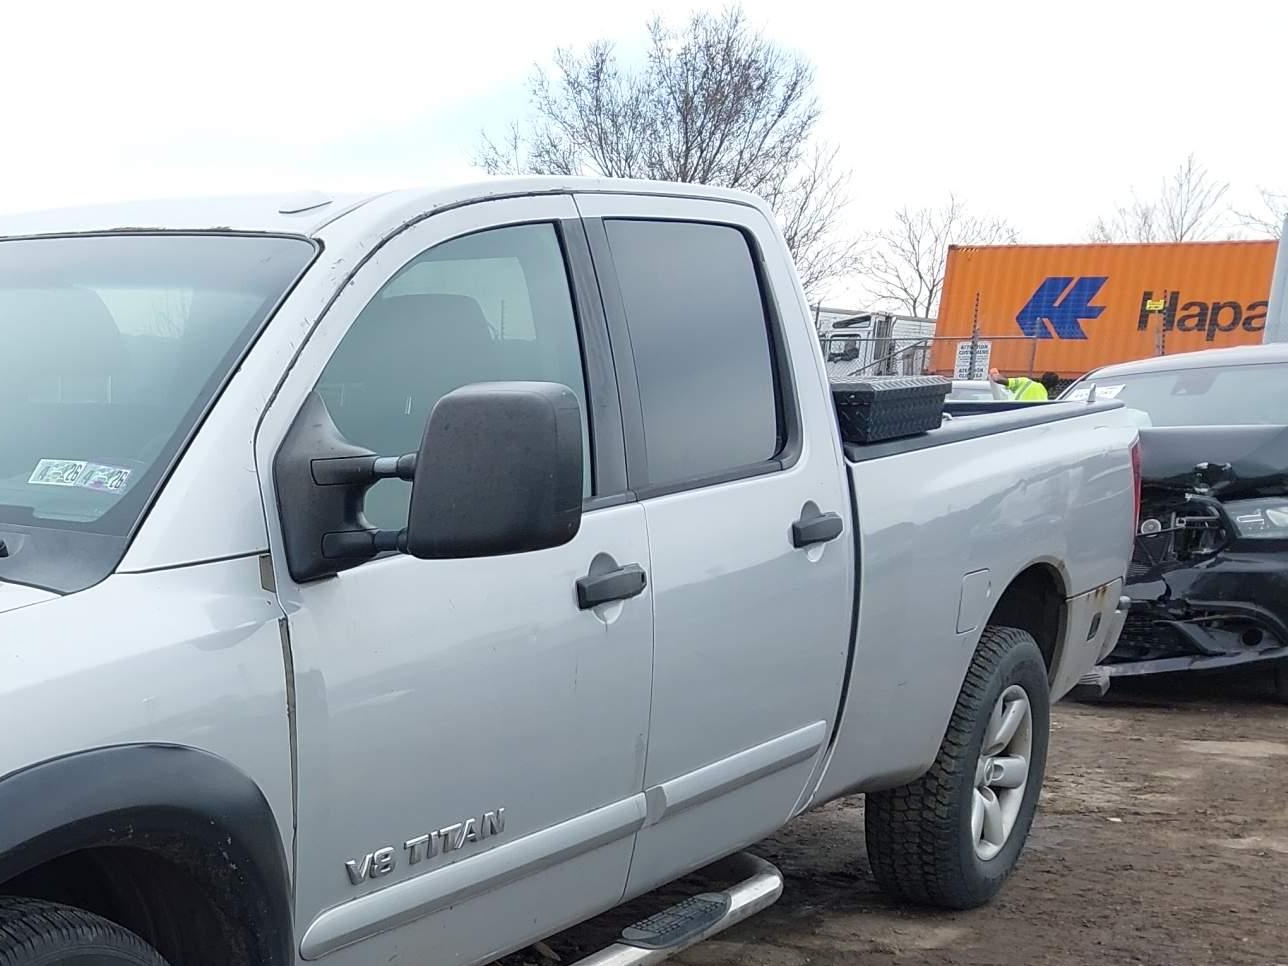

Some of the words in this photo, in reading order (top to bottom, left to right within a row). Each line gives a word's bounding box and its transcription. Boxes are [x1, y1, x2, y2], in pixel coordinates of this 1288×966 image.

[1137, 291, 1269, 341] Hapa
[65, 463, 83, 482] 26
[345, 846, 396, 886] V8
[404, 807, 506, 865] TITAN
